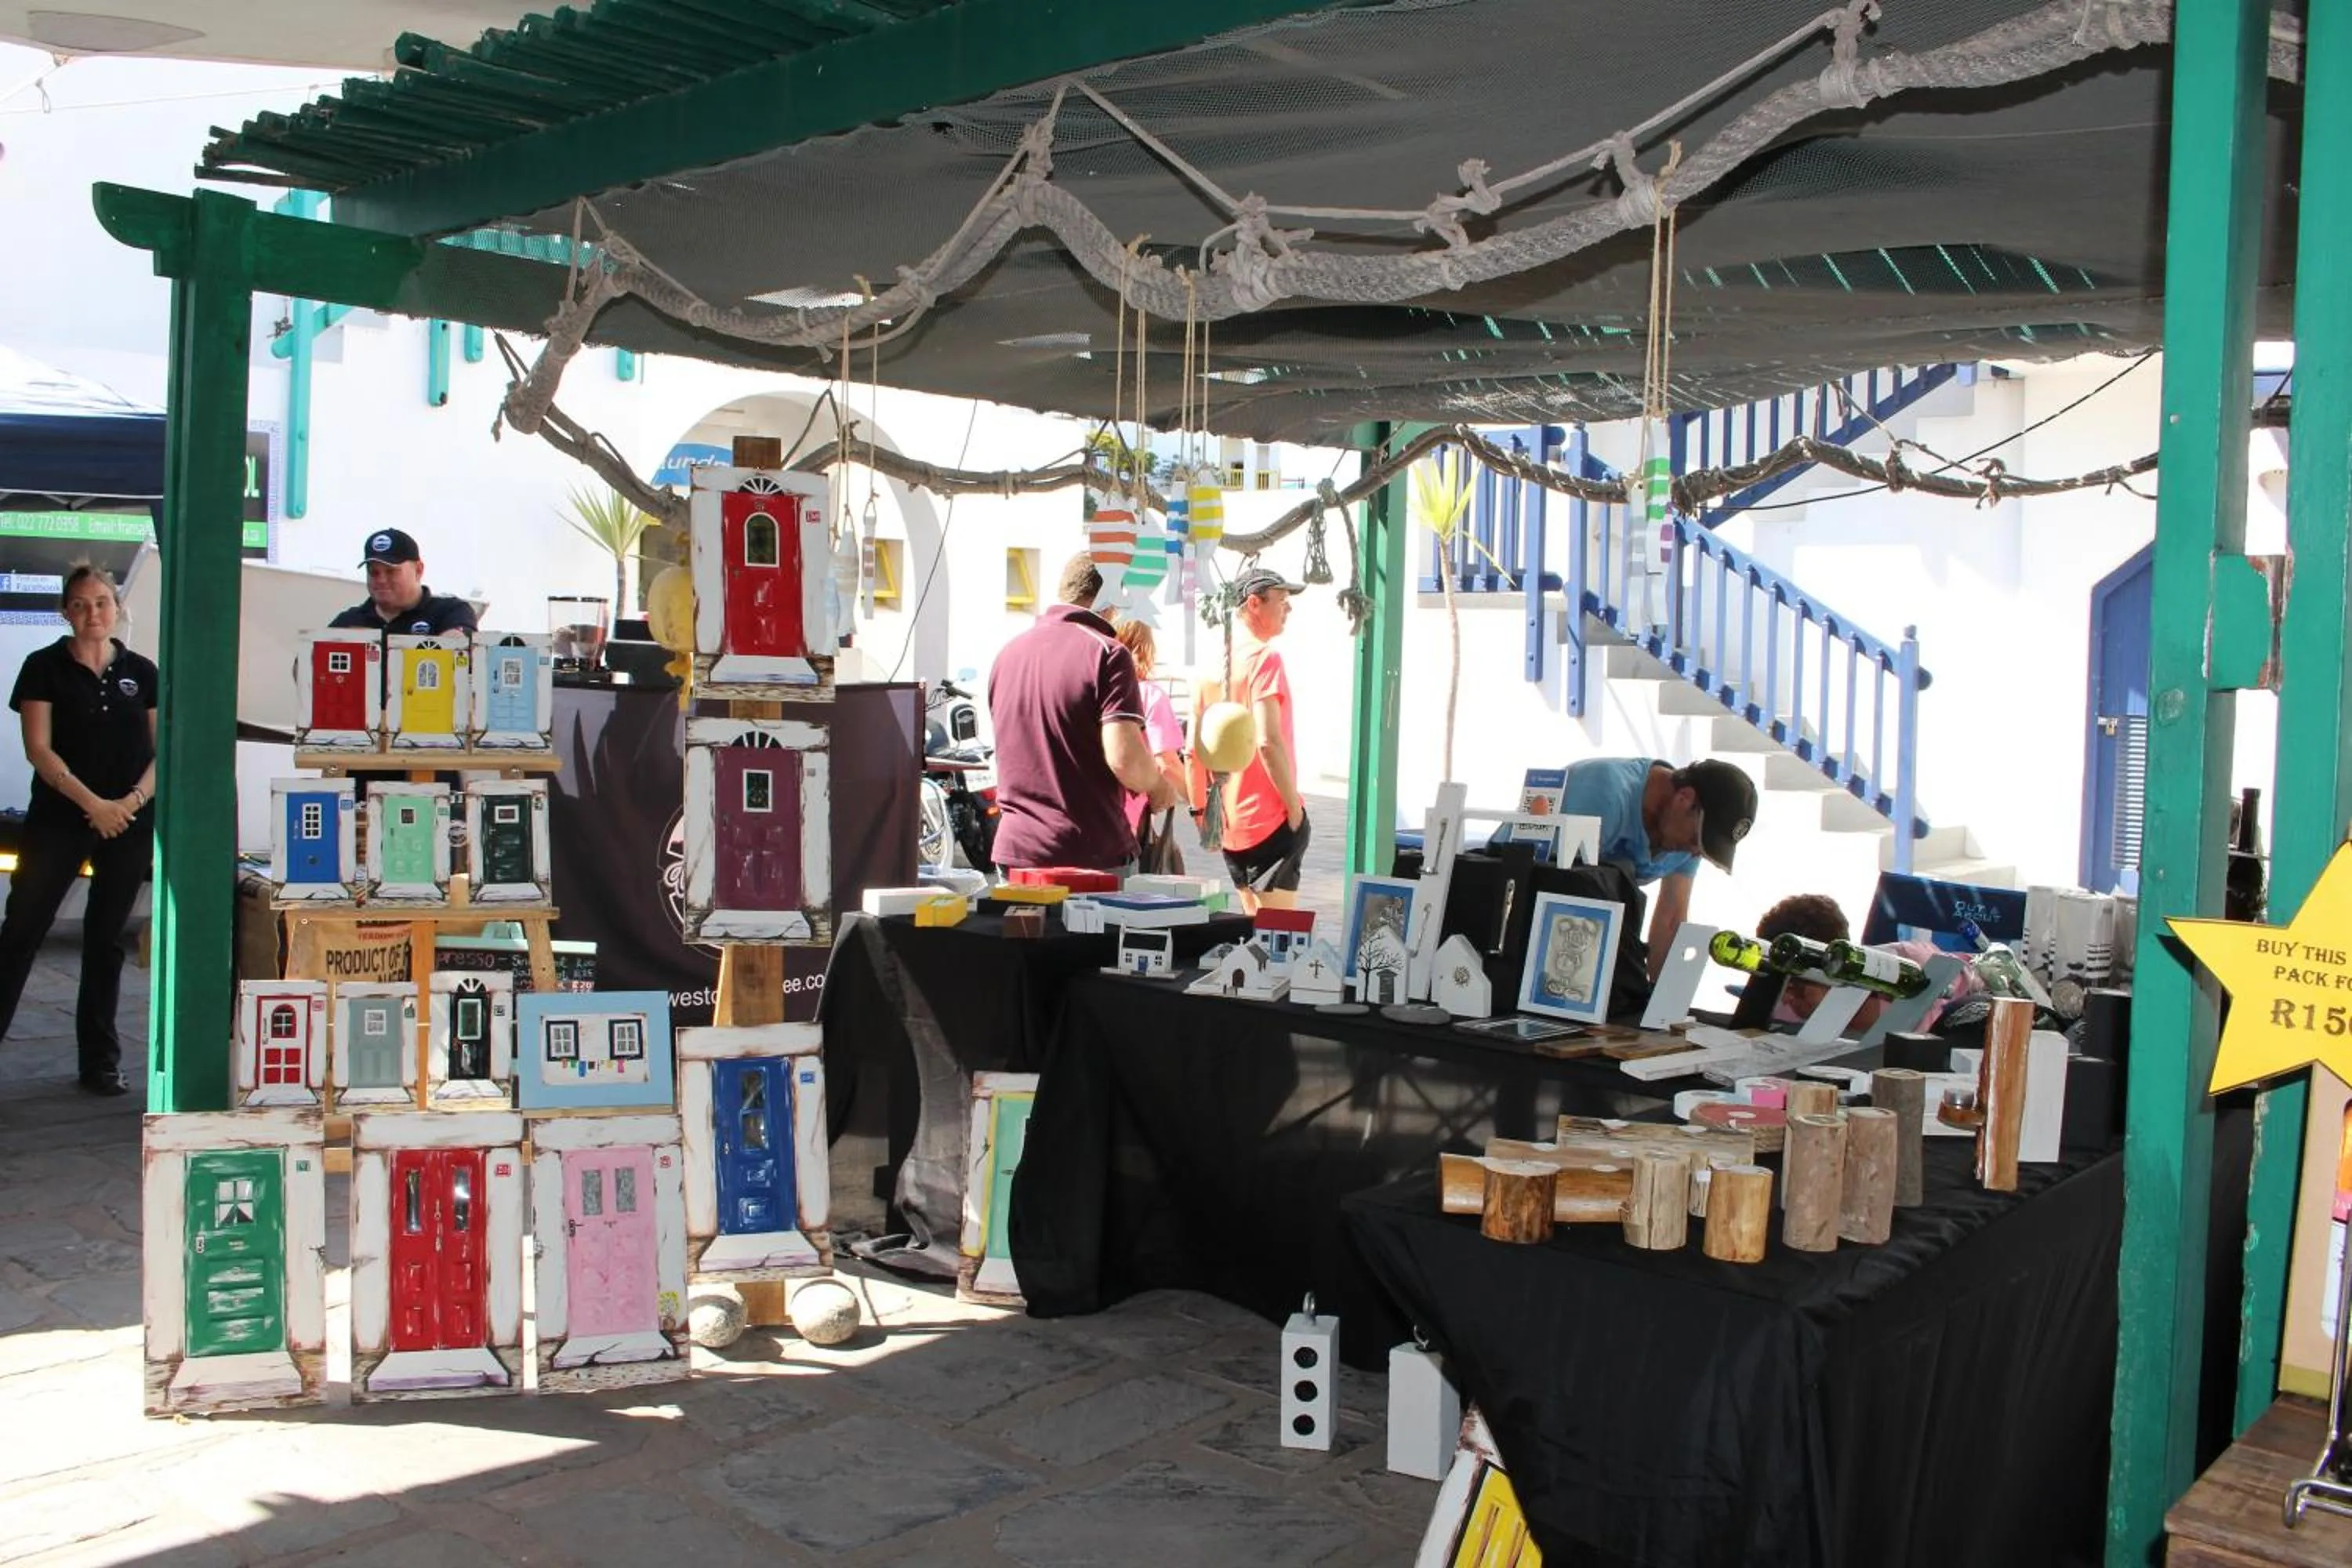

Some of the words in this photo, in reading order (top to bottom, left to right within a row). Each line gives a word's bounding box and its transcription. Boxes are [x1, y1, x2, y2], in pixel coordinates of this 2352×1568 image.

[325, 947, 387, 975] PRODUCT
[436, 951, 495, 971] presso
[2256, 938, 2299, 958] BUY
[2302, 945, 2347, 966] THIS
[2272, 965, 2331, 988] PACK
[2270, 998, 2352, 1037] R15
